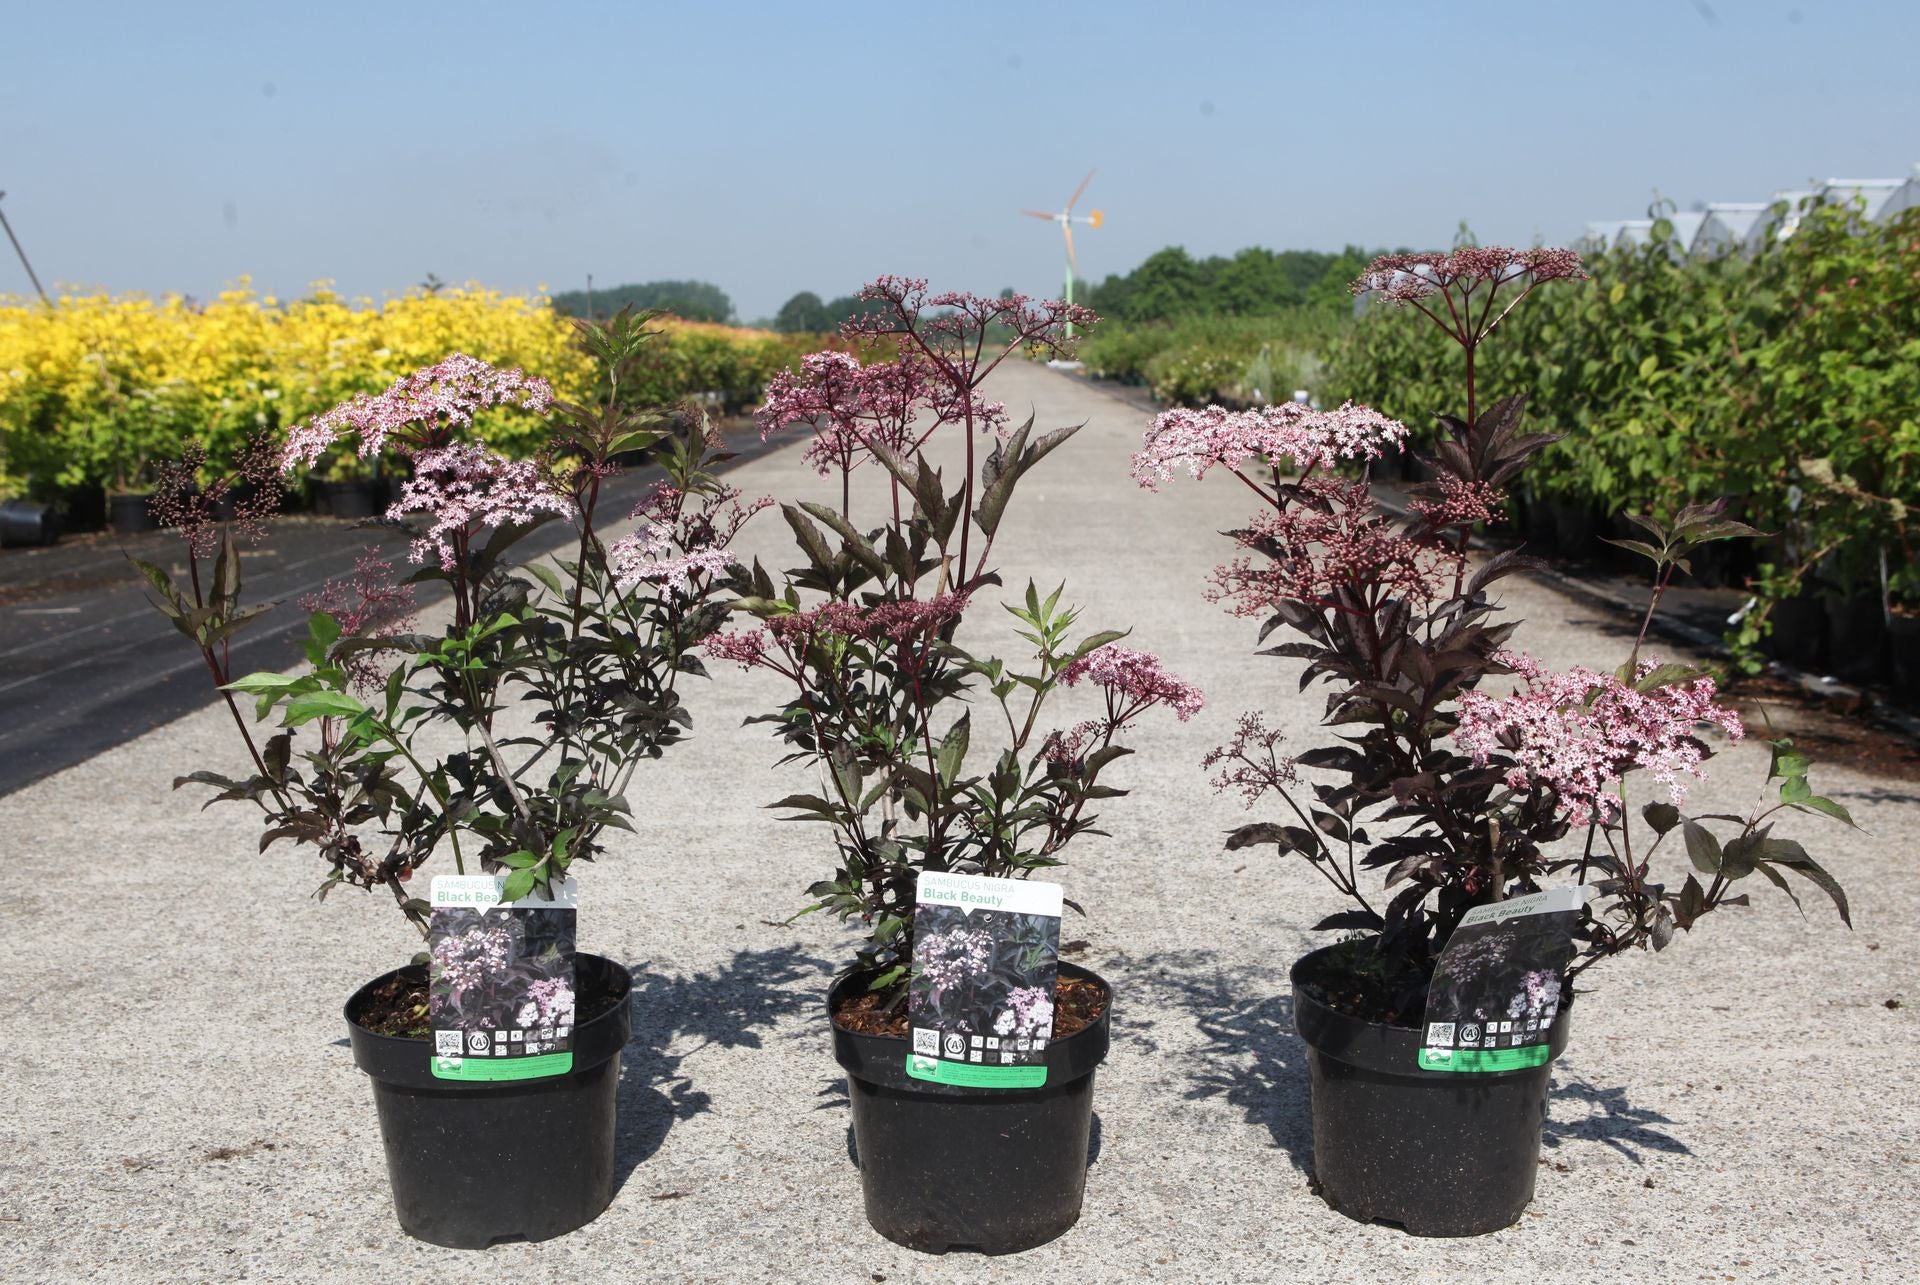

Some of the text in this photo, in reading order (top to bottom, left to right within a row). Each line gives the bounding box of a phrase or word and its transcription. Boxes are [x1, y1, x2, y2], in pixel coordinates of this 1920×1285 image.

[437, 881, 494, 890] SAMBUCUS
[924, 877, 1015, 894] SAMBUCUS NIGRA
[437, 891, 500, 902] Black Bea
[923, 888, 1003, 907] Black Beauty
[1466, 905, 1535, 924] Black Beauty
